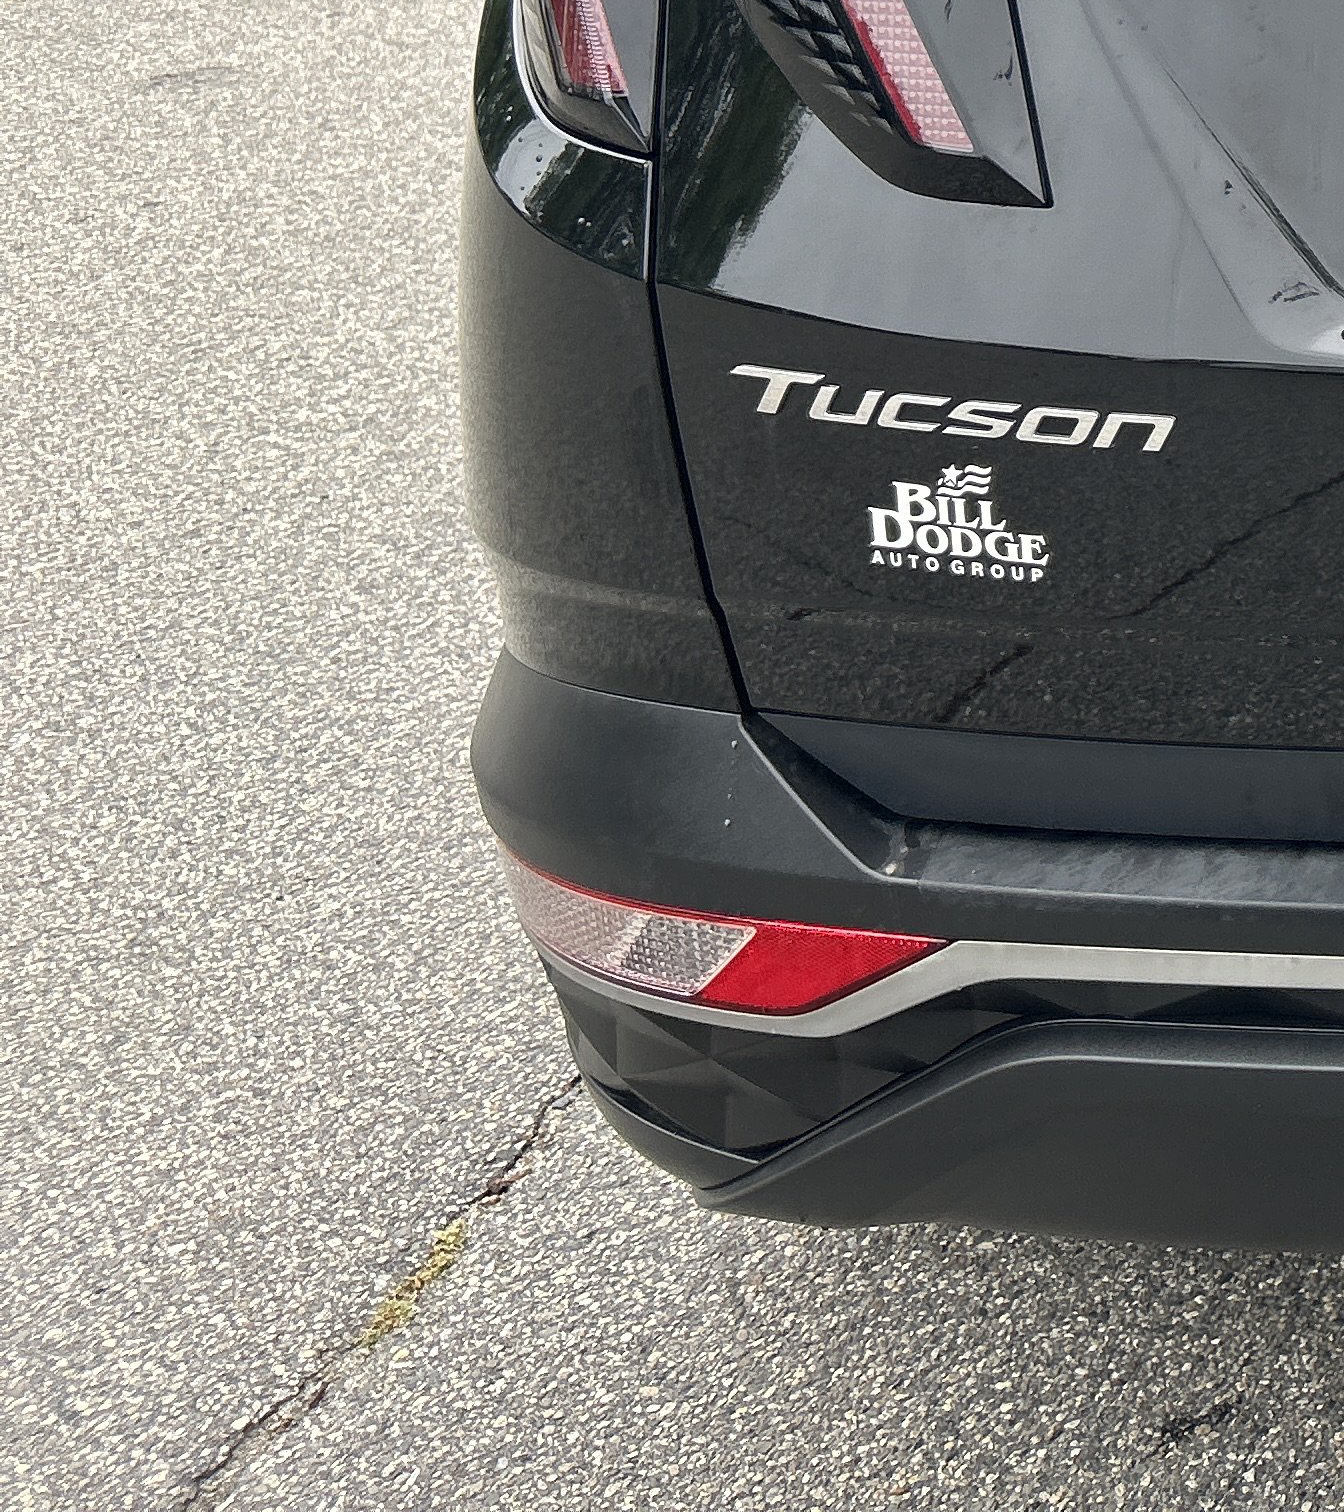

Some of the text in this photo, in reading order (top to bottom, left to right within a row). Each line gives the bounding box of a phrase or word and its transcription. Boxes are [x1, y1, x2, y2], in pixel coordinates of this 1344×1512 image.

[729, 363, 1177, 452] TUCSON
[891, 480, 1007, 531] BILL
[867, 506, 1050, 567] DODGE
[870, 549, 1045, 583] AUTO GROUP
